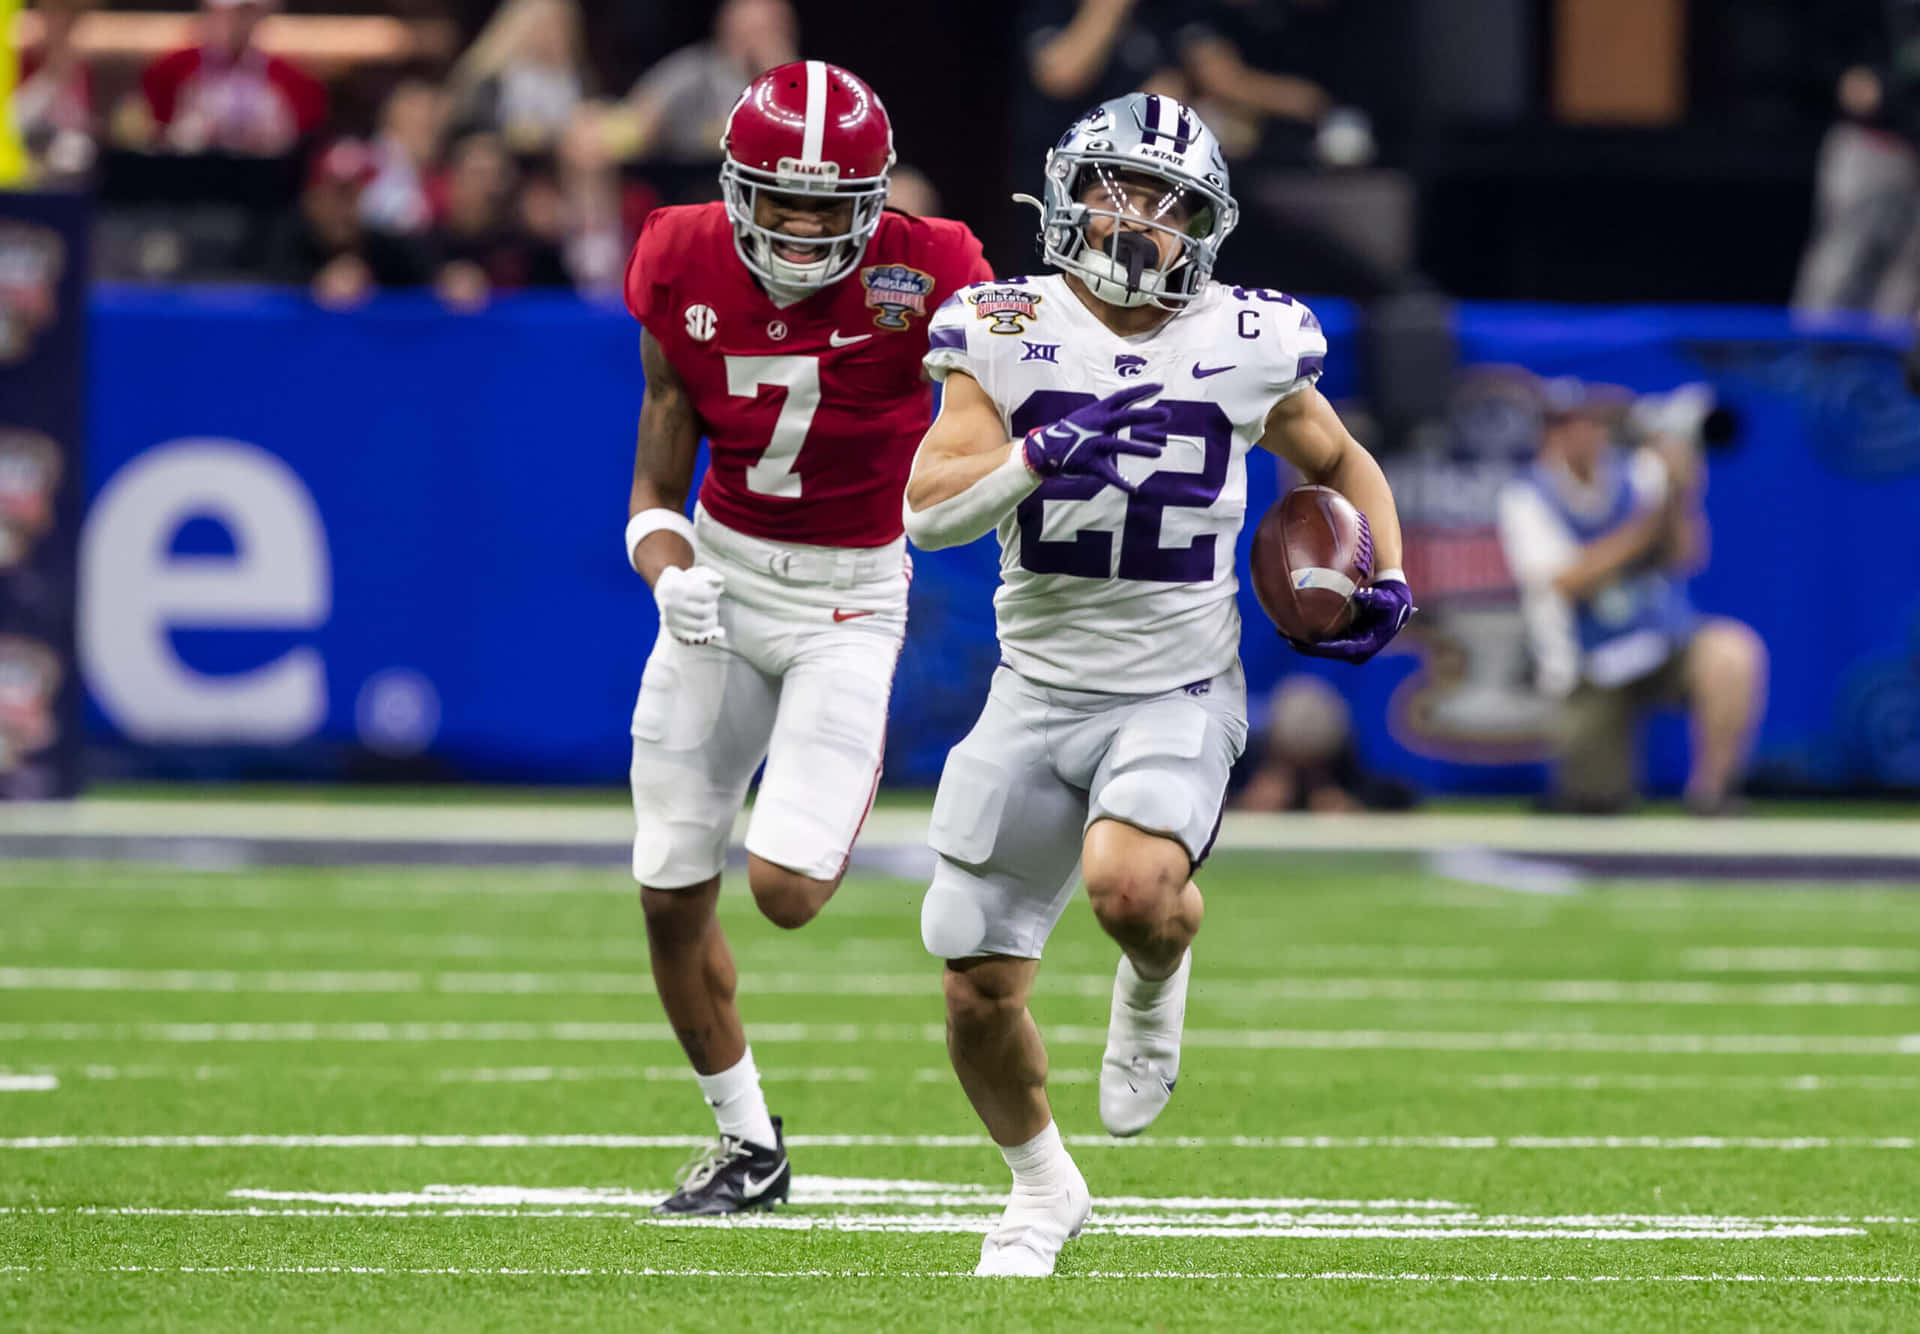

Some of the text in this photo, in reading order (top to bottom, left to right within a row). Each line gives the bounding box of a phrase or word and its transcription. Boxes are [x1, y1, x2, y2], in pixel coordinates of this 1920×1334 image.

[685, 304, 718, 341] SEC
[1238, 310, 1260, 339] C
[1021, 340, 1061, 364] XII
[724, 355, 822, 498] 7
[1011, 390, 1234, 583] 22
